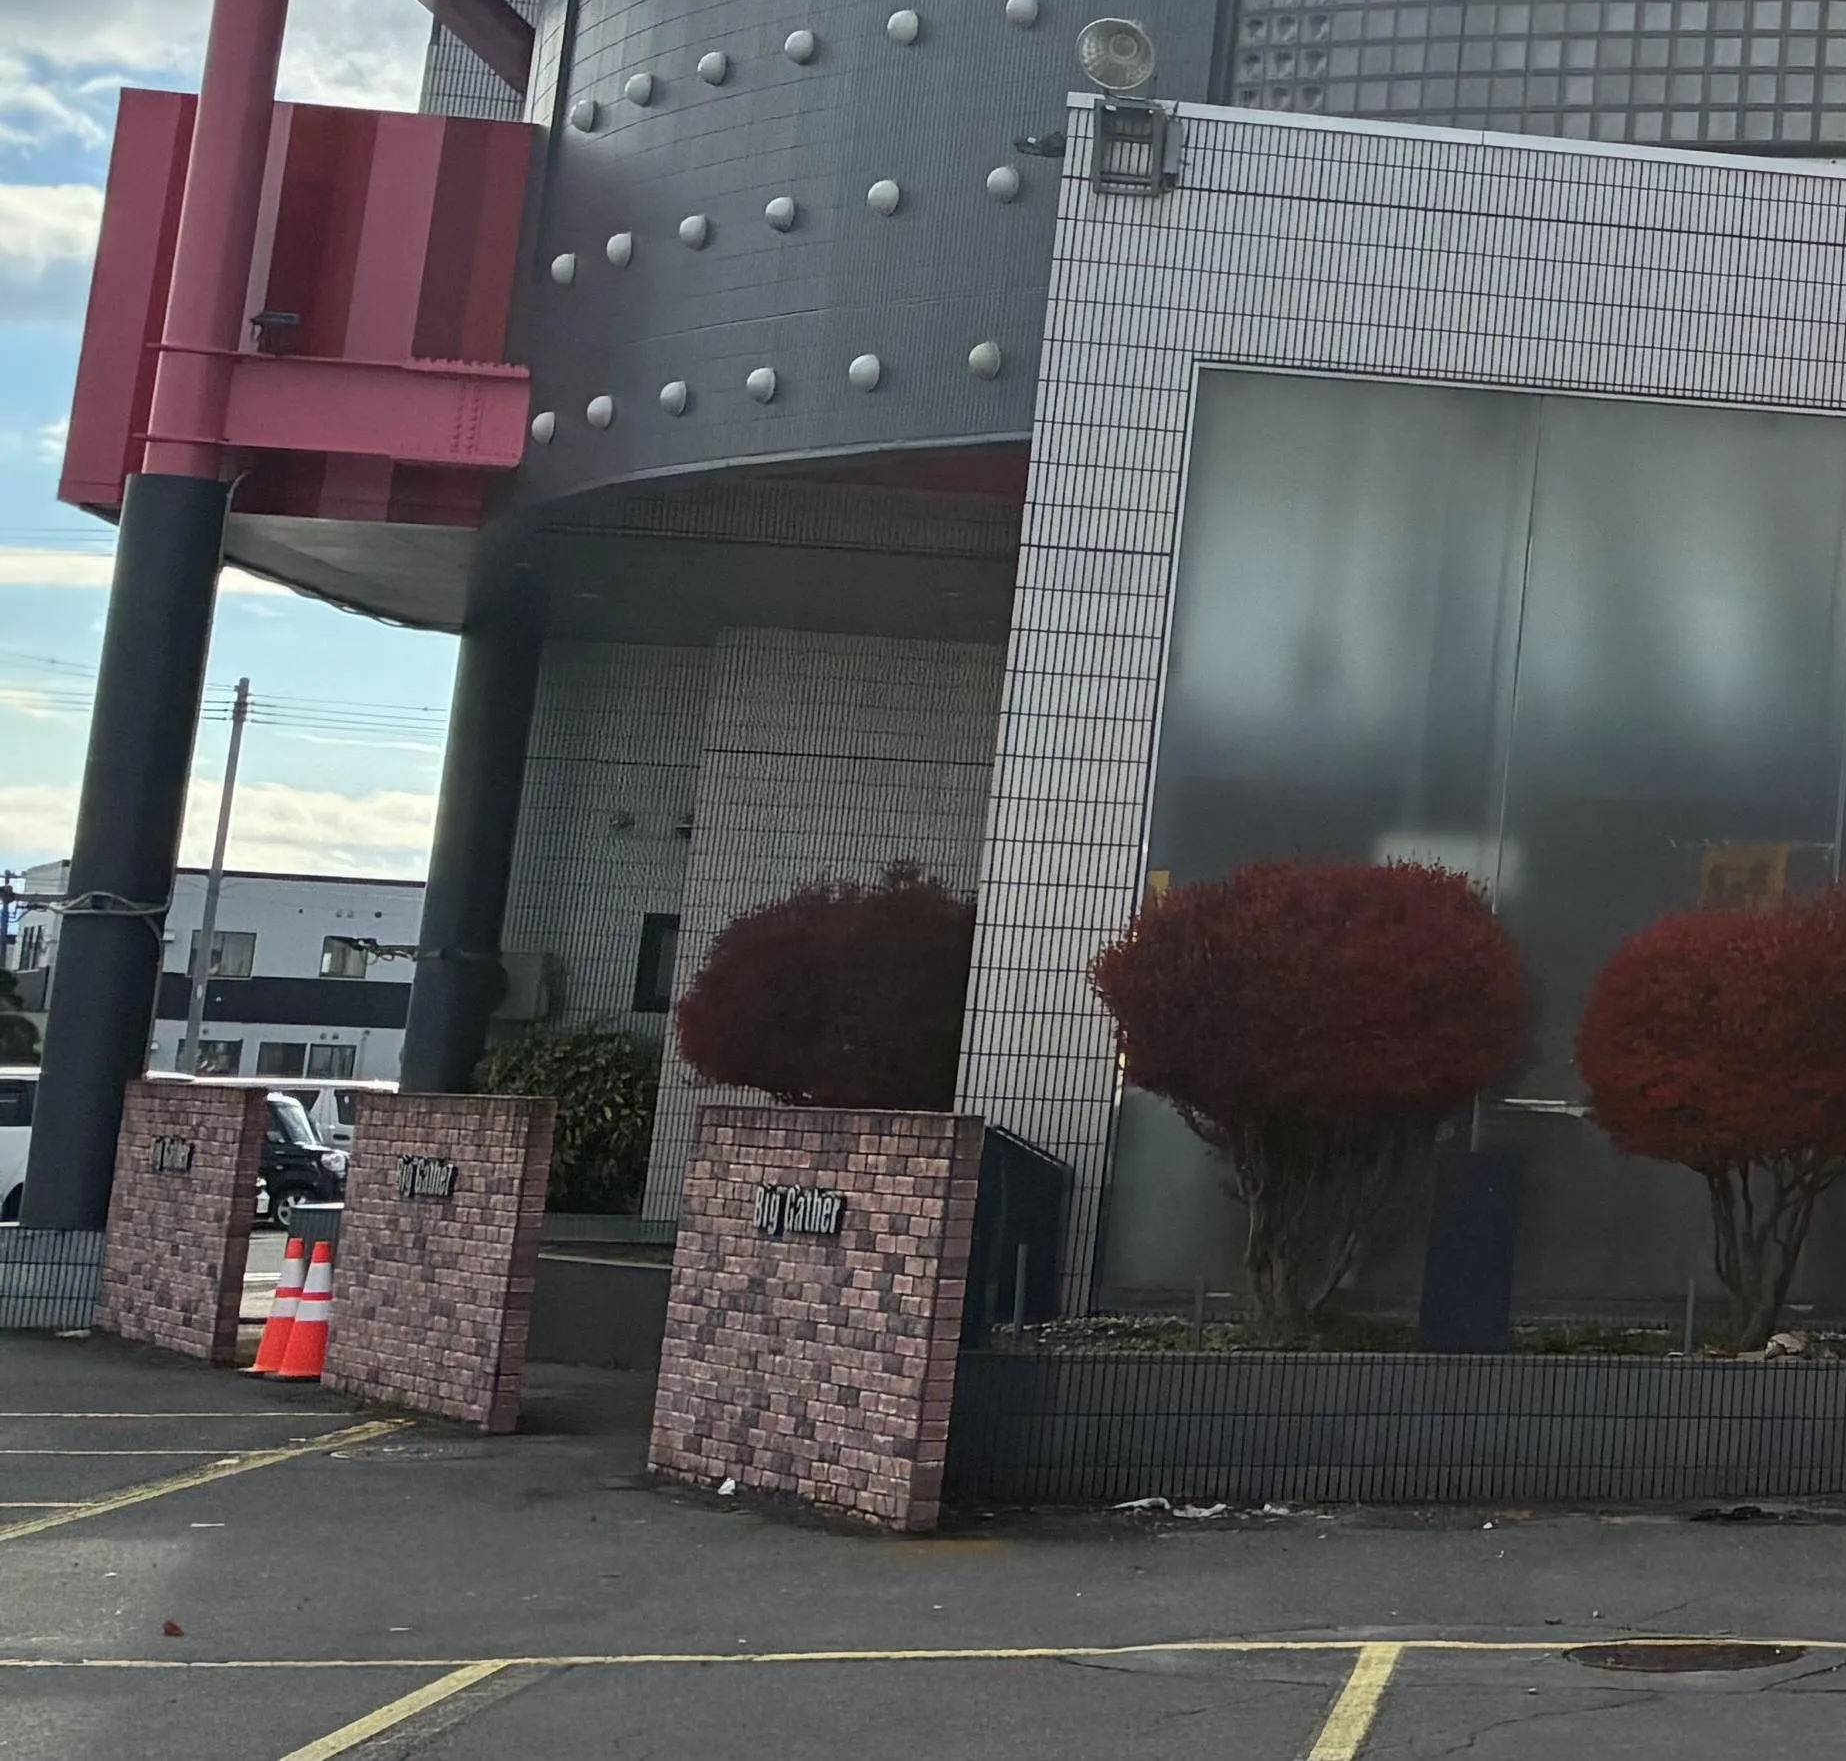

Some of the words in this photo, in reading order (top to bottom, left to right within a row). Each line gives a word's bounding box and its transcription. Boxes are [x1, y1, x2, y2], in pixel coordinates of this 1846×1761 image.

[396, 1155, 414, 1197] Big
[414, 1157, 454, 1196] Gather
[754, 1185, 781, 1235] Big
[783, 1186, 842, 1234] Gather
